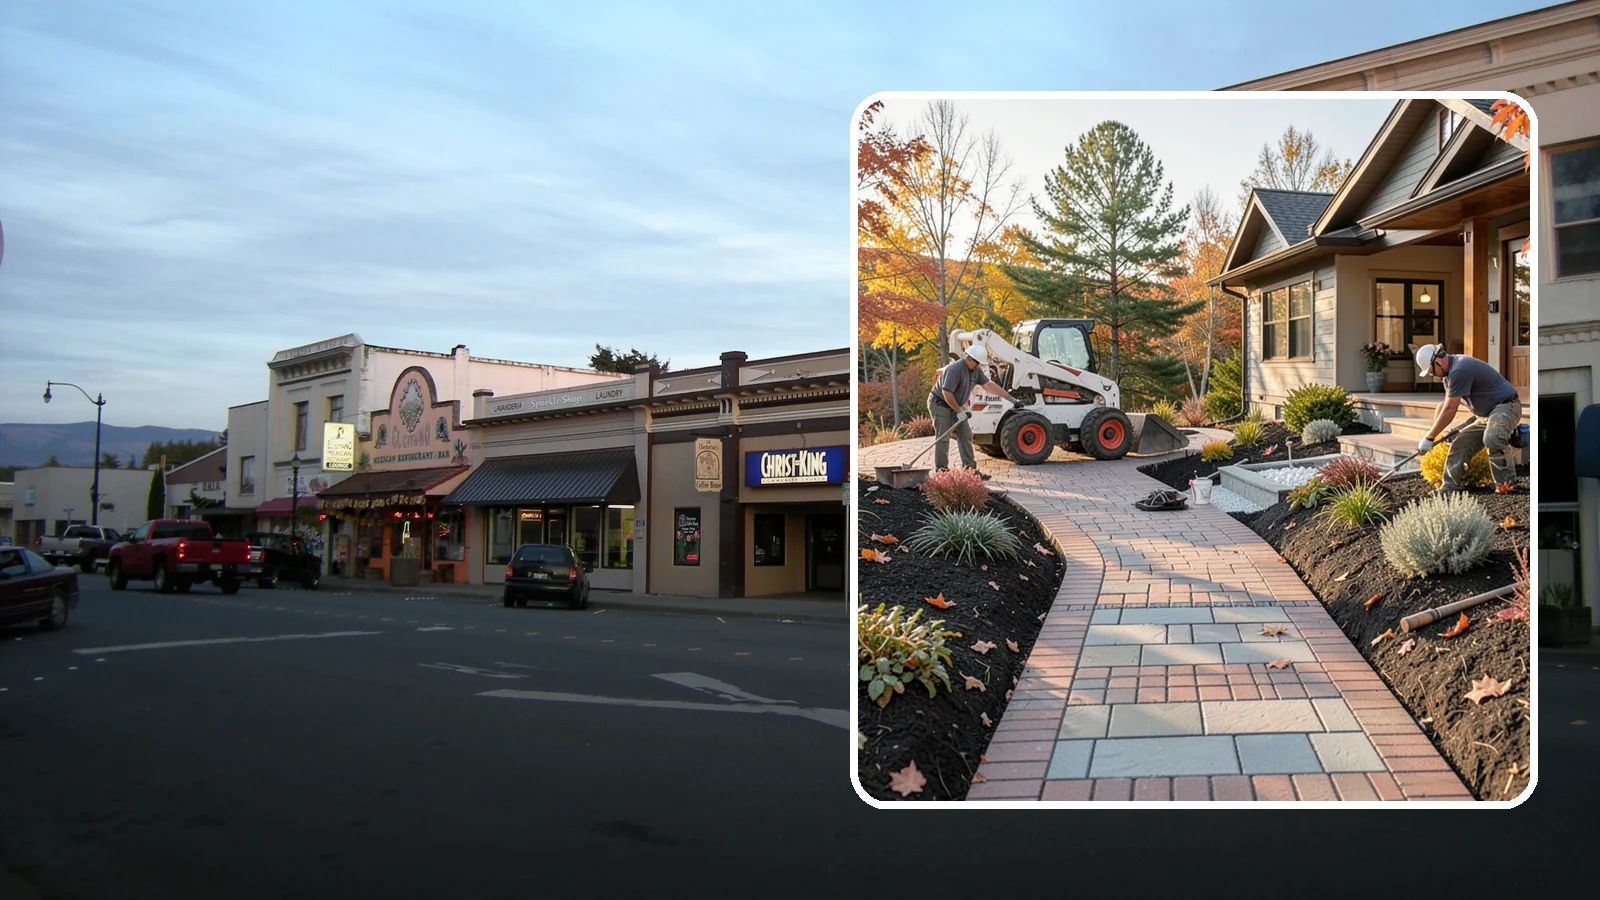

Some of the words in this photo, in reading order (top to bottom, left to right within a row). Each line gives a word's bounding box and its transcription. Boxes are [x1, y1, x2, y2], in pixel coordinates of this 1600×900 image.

[562, 394, 582, 405] Shop
[595, 389, 623, 400] LAUNDRY
[493, 402, 523, 413] LAVANDERIA
[373, 455, 396, 464] MEXICAN
[397, 451, 433, 462] RESTAURANT
[437, 450, 450, 459] BAR
[761, 452, 797, 477] CHRIST
[799, 450, 827, 476] KING
